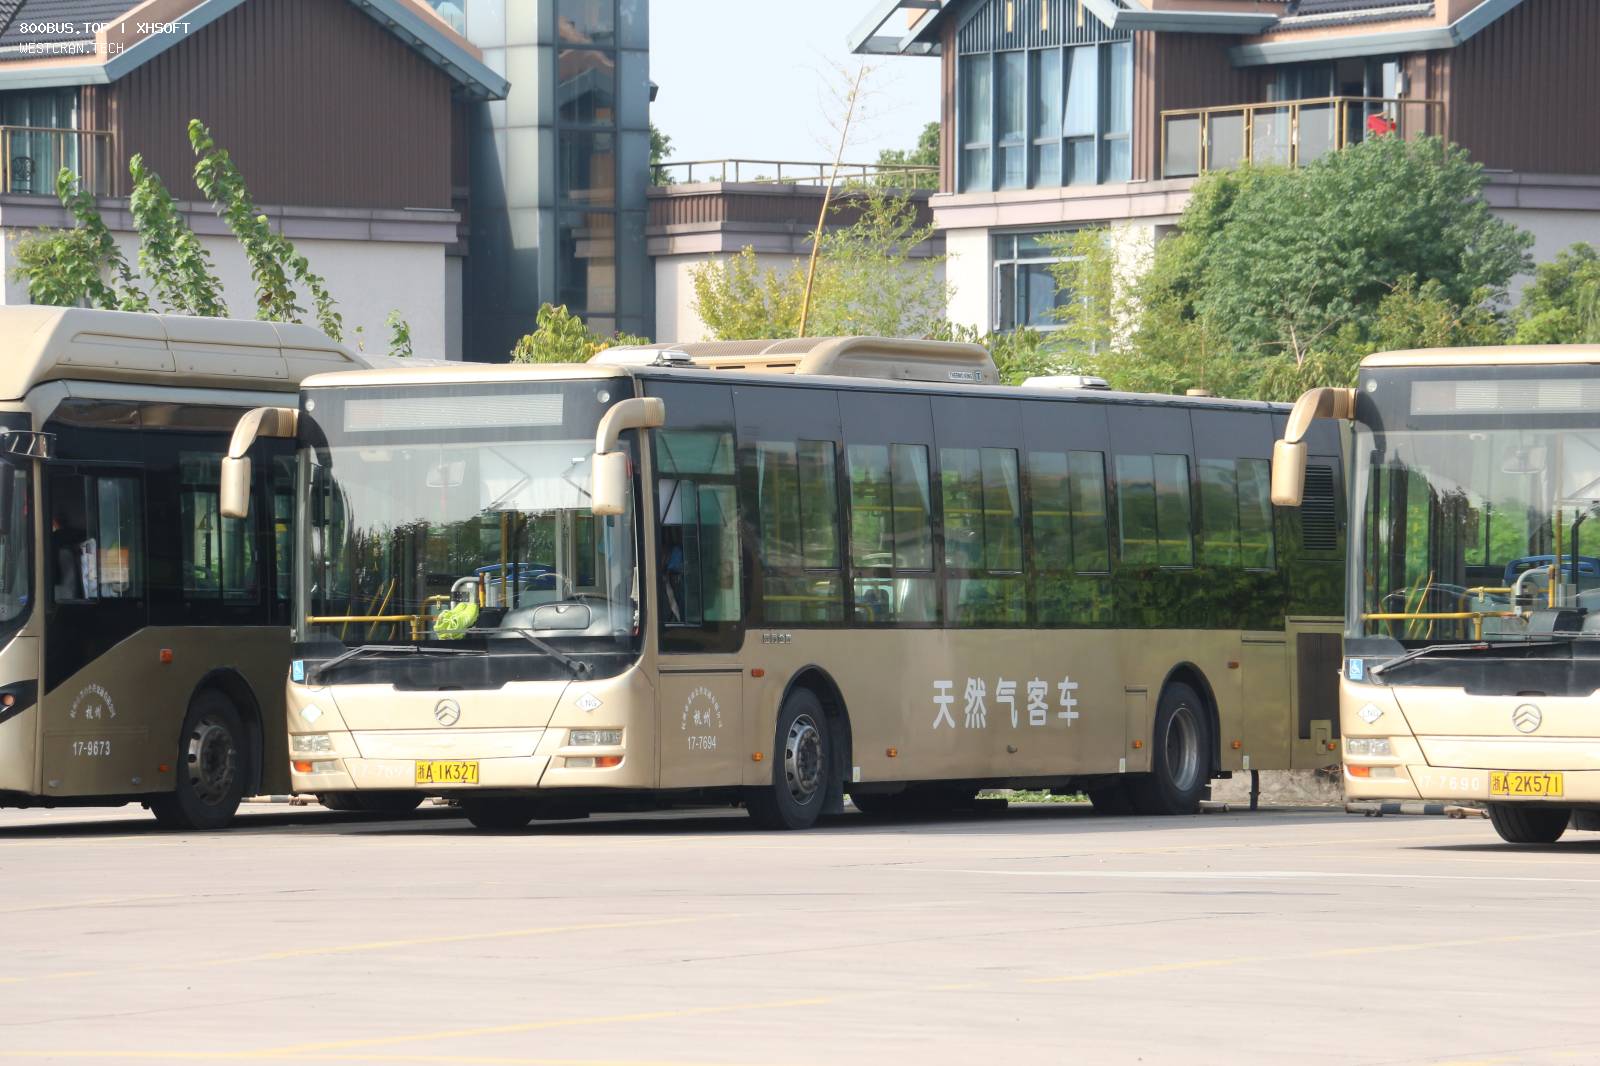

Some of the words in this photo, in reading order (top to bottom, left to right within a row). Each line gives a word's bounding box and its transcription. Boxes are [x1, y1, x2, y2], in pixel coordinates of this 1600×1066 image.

[932, 675, 1080, 729] 天然气客车
[72, 740, 111, 756] 17-9673
[687, 735, 717, 751] 17-7694
